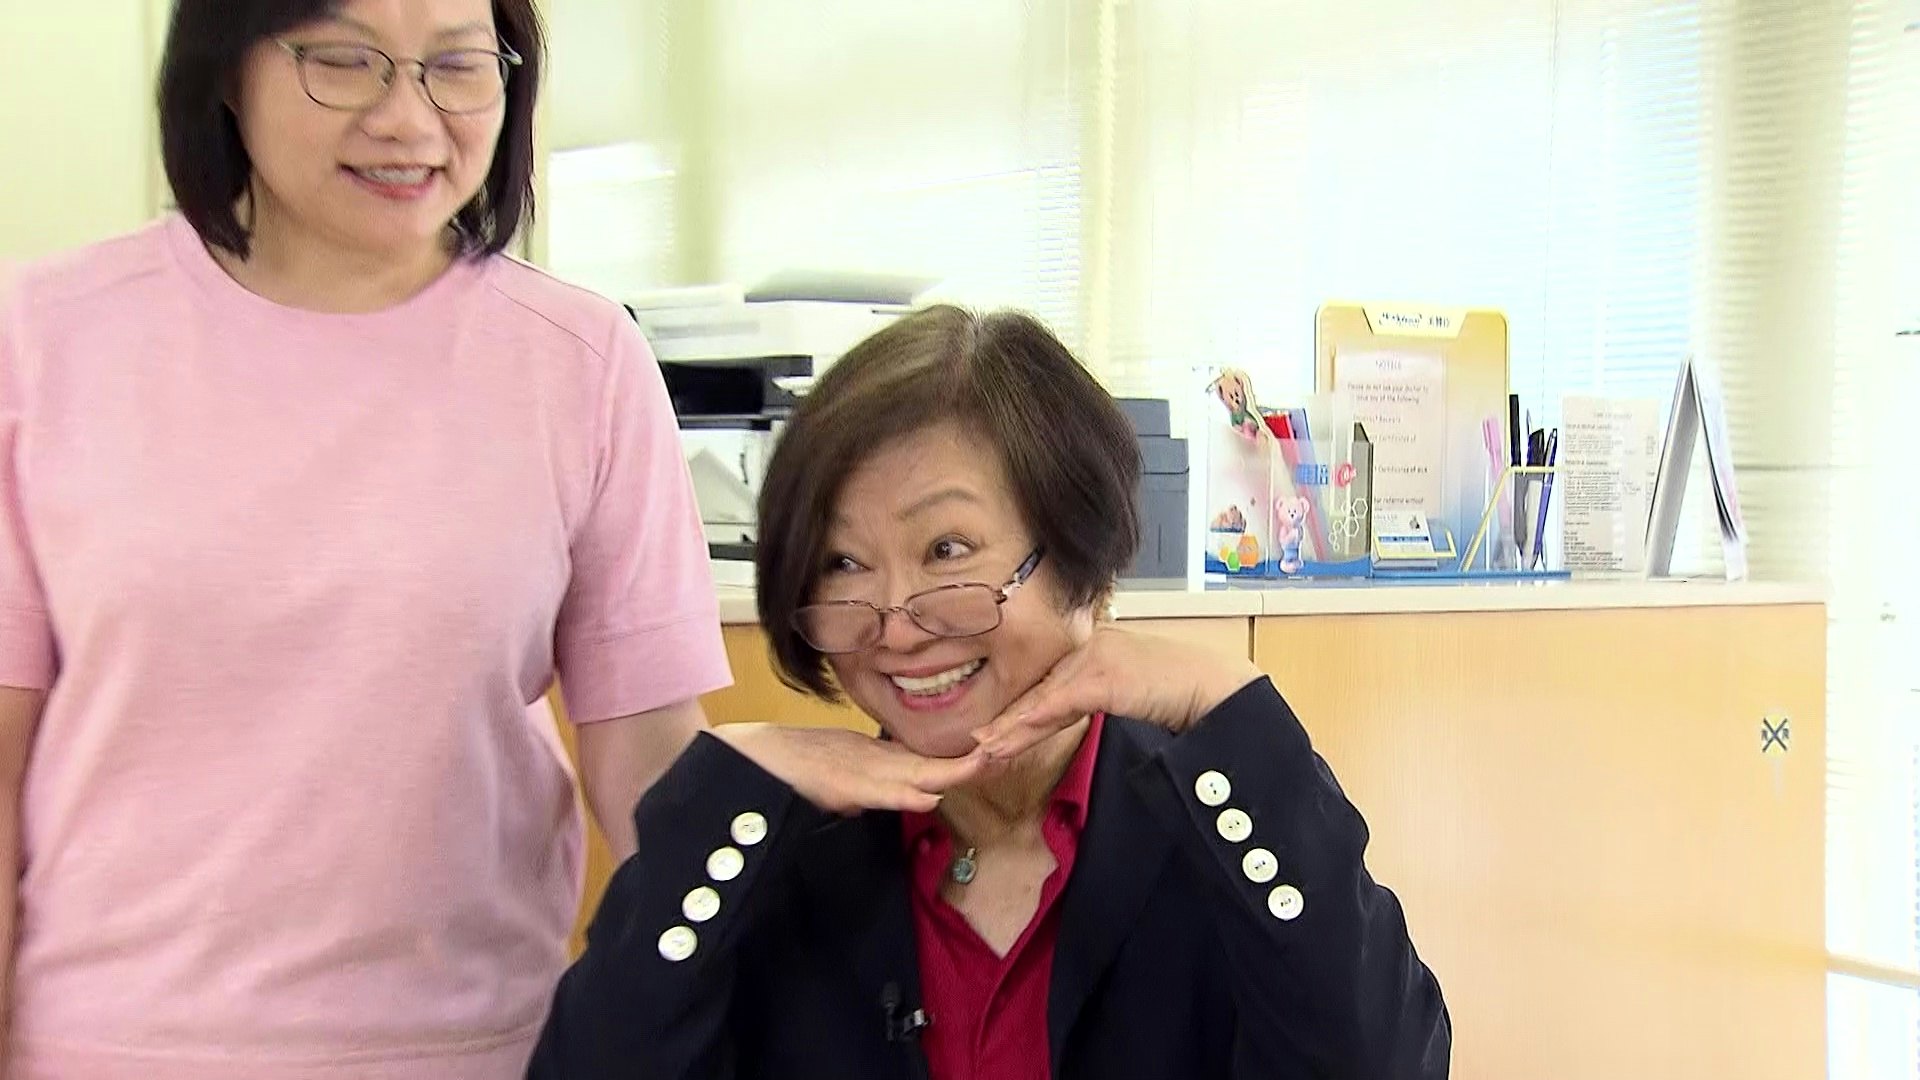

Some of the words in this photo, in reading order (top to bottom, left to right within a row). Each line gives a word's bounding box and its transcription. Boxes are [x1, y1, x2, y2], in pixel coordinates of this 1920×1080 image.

[1347, 382, 1364, 391] Please
[1365, 383, 1372, 391] do
[1373, 383, 1382, 391] not
[1392, 384, 1404, 393] your
[1405, 383, 1421, 392] doctor
[1387, 394, 1396, 402] the
